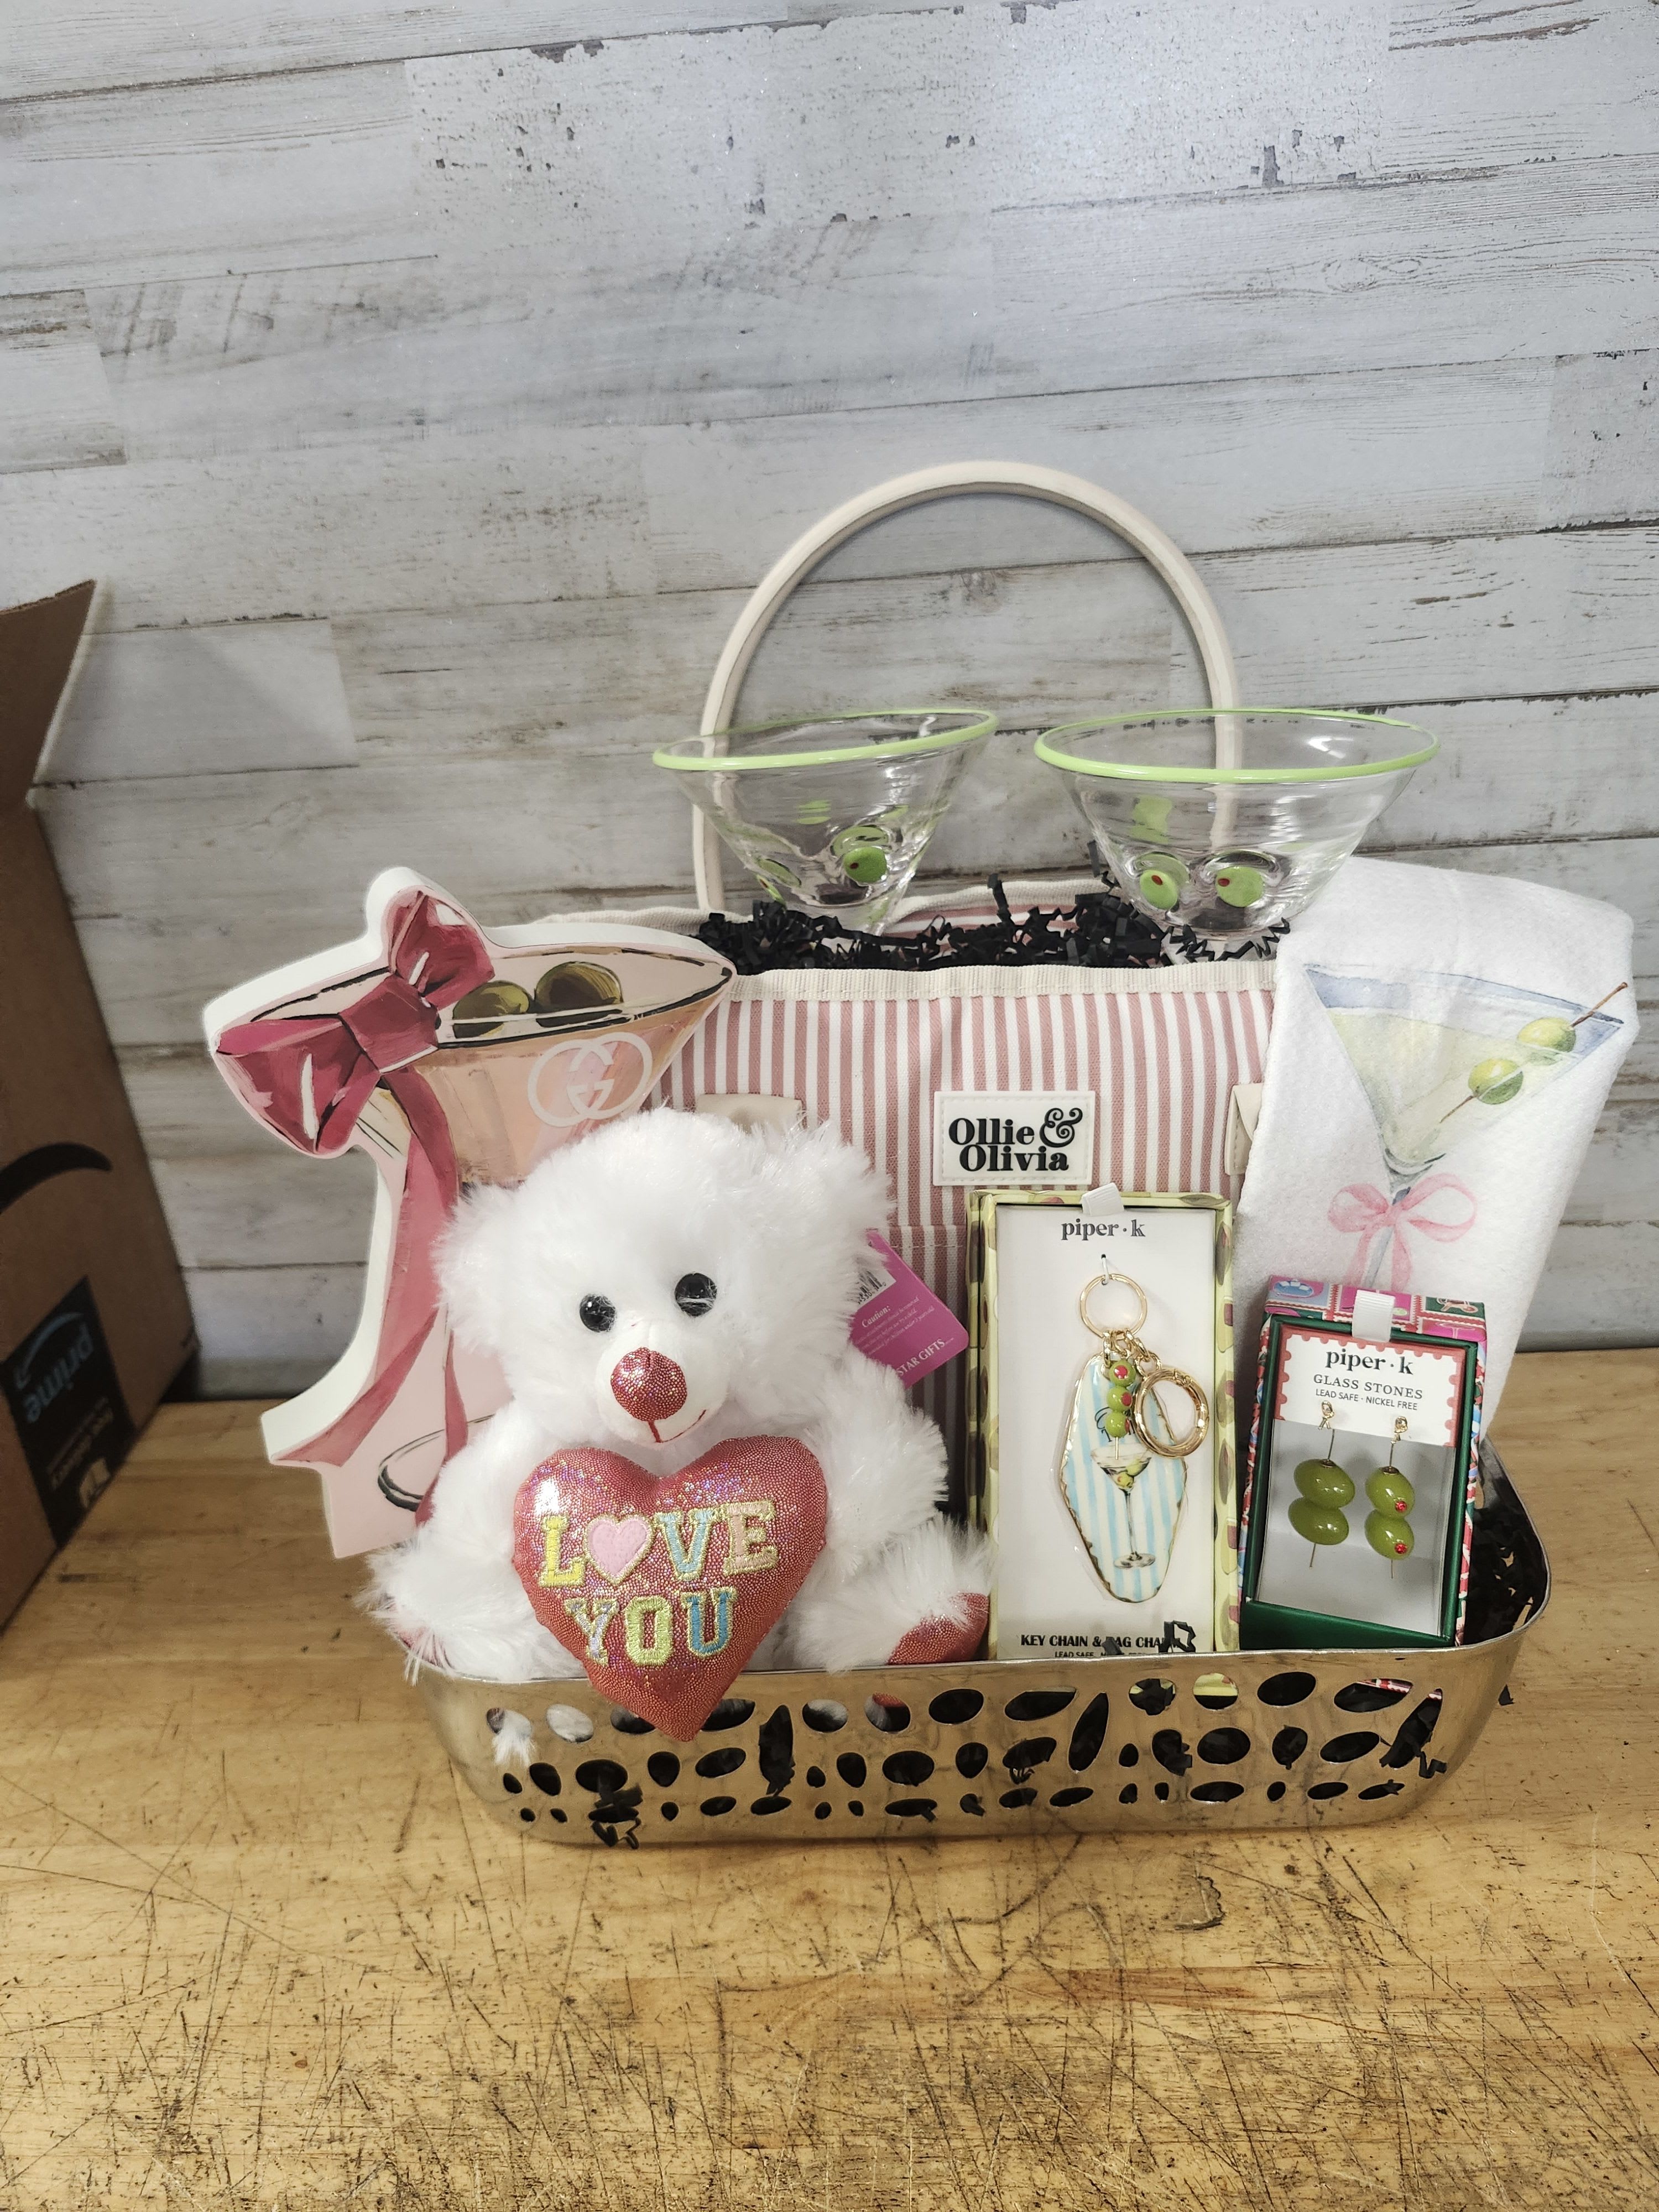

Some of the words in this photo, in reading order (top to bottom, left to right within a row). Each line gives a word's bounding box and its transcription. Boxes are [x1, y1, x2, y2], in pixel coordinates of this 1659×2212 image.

[948, 1118, 1035, 1145] Ollie
[1040, 1108, 1083, 1148] &
[959, 1144, 1069, 1172] Olivia
[862, 1306, 891, 1327] Caution:
[896, 1357, 920, 1376] STAR
[919, 1338, 945, 1360] GIFTS
[23, 1323, 93, 1422] prime
[1313, 1374, 1359, 1389] GLASS
[1364, 1382, 1423, 1399] STONES
[1316, 1389, 1337, 1399] LEAD
[1338, 1392, 1359, 1402] SAFE
[1366, 1396, 1395, 1407] NICKEL
[1397, 1401, 1418, 1411] FREE
[564, 1587, 737, 1666] YOU
[1021, 1634, 1045, 1646] KEY
[1050, 1635, 1088, 1647] CHAIN
[1092, 1636, 1102, 1647] &
[1107, 1636, 1131, 1647] AG
